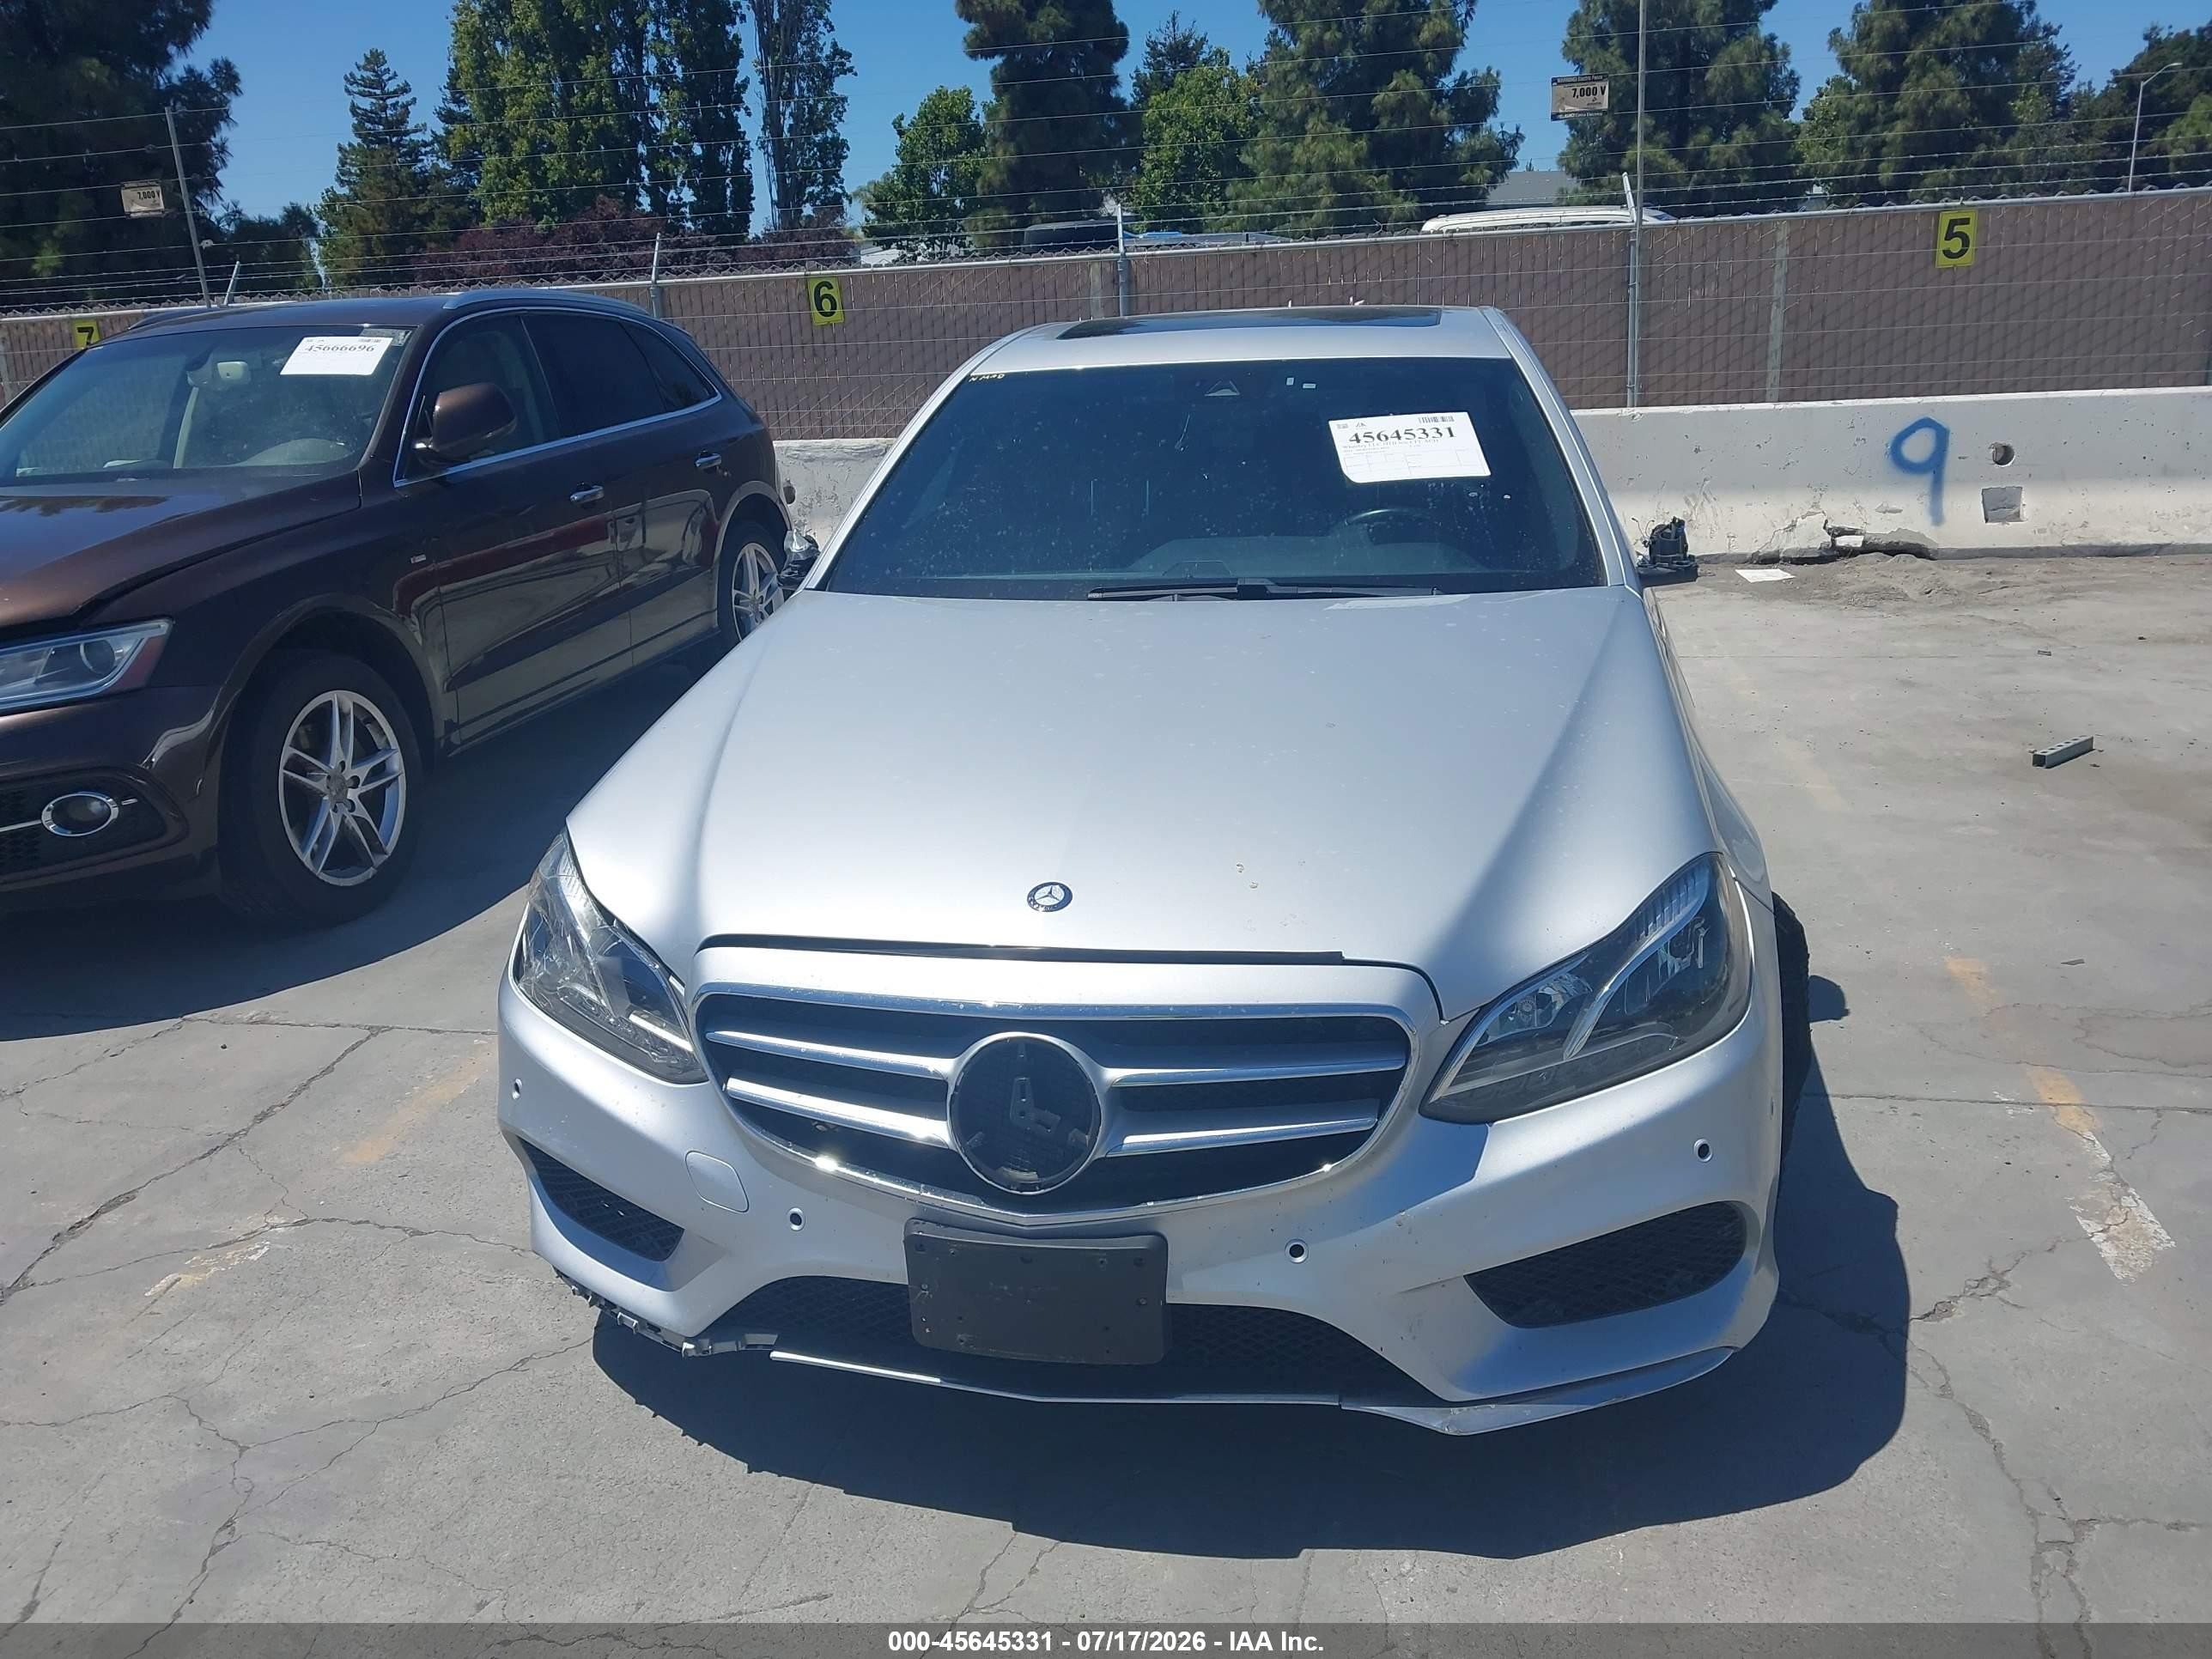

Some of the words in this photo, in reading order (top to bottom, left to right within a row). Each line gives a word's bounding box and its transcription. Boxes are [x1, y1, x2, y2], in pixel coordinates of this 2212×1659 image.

[1571, 87, 1598, 99] 7,000
[1600, 86, 1607, 95] V
[137, 191, 155, 200] 7,000
[1942, 217, 1971, 258] 5
[813, 280, 837, 317] 6
[76, 326, 94, 345] 7
[304, 344, 376, 353] 45666696
[1348, 426, 1457, 445] 45645331
[1890, 416, 1950, 526] 9
